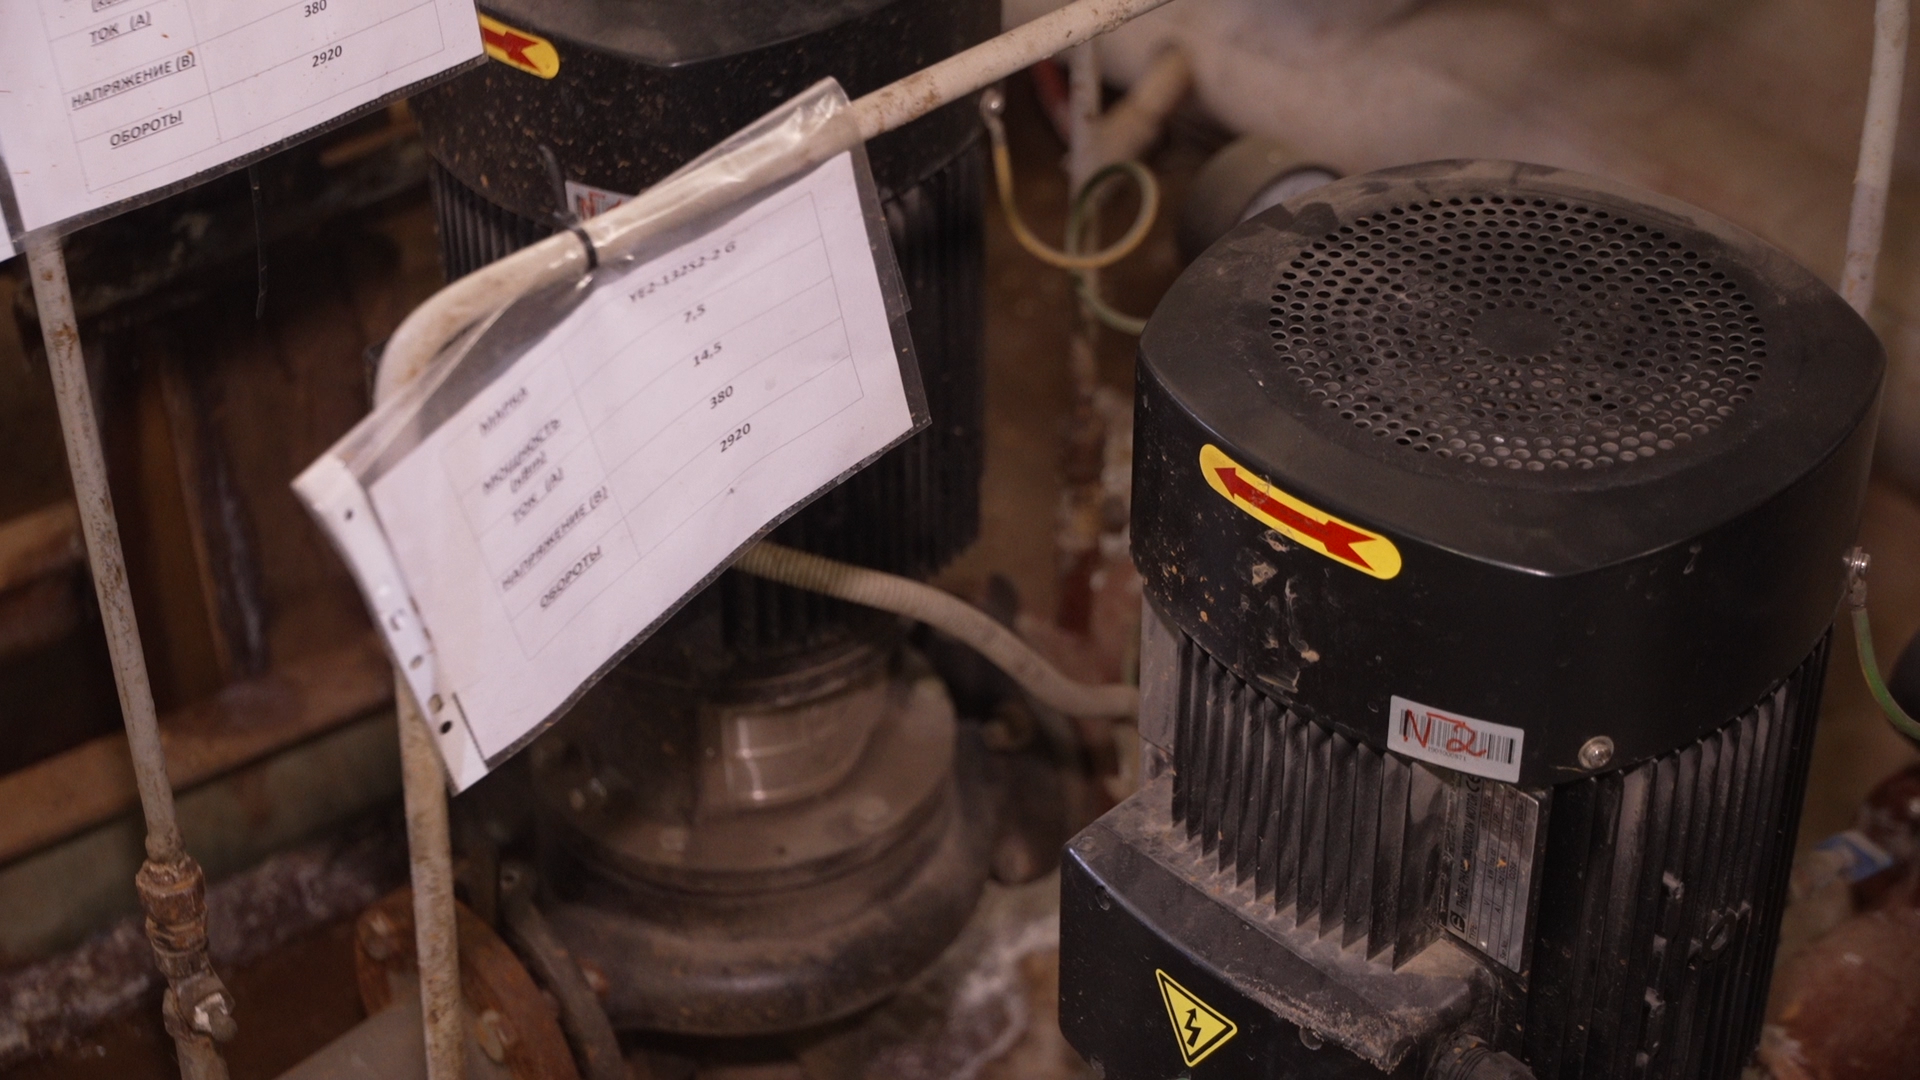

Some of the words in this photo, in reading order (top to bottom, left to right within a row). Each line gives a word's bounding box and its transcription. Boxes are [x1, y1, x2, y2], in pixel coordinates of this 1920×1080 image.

[303, 0, 328, 18] 380
[89, 22, 120, 47] ТОК
[129, 11, 152, 31] (А)
[311, 45, 343, 68] 2920
[71, 61, 173, 110] НАПРЯЖЕНИЕ
[175, 52, 197, 72] (В)
[109, 110, 184, 149] ОБОРОТЫ
[479, 386, 530, 437] МАРКА
[710, 385, 734, 410] 380
[720, 422, 752, 453] 2920
[482, 418, 561, 495] МОЩНОСТЬ
[512, 493, 540, 526] ТОК
[502, 503, 587, 592] НАПРЯЖЕНИЕ
[588, 484, 609, 511] (В)
[539, 545, 604, 610] ОБОРОТЫ
